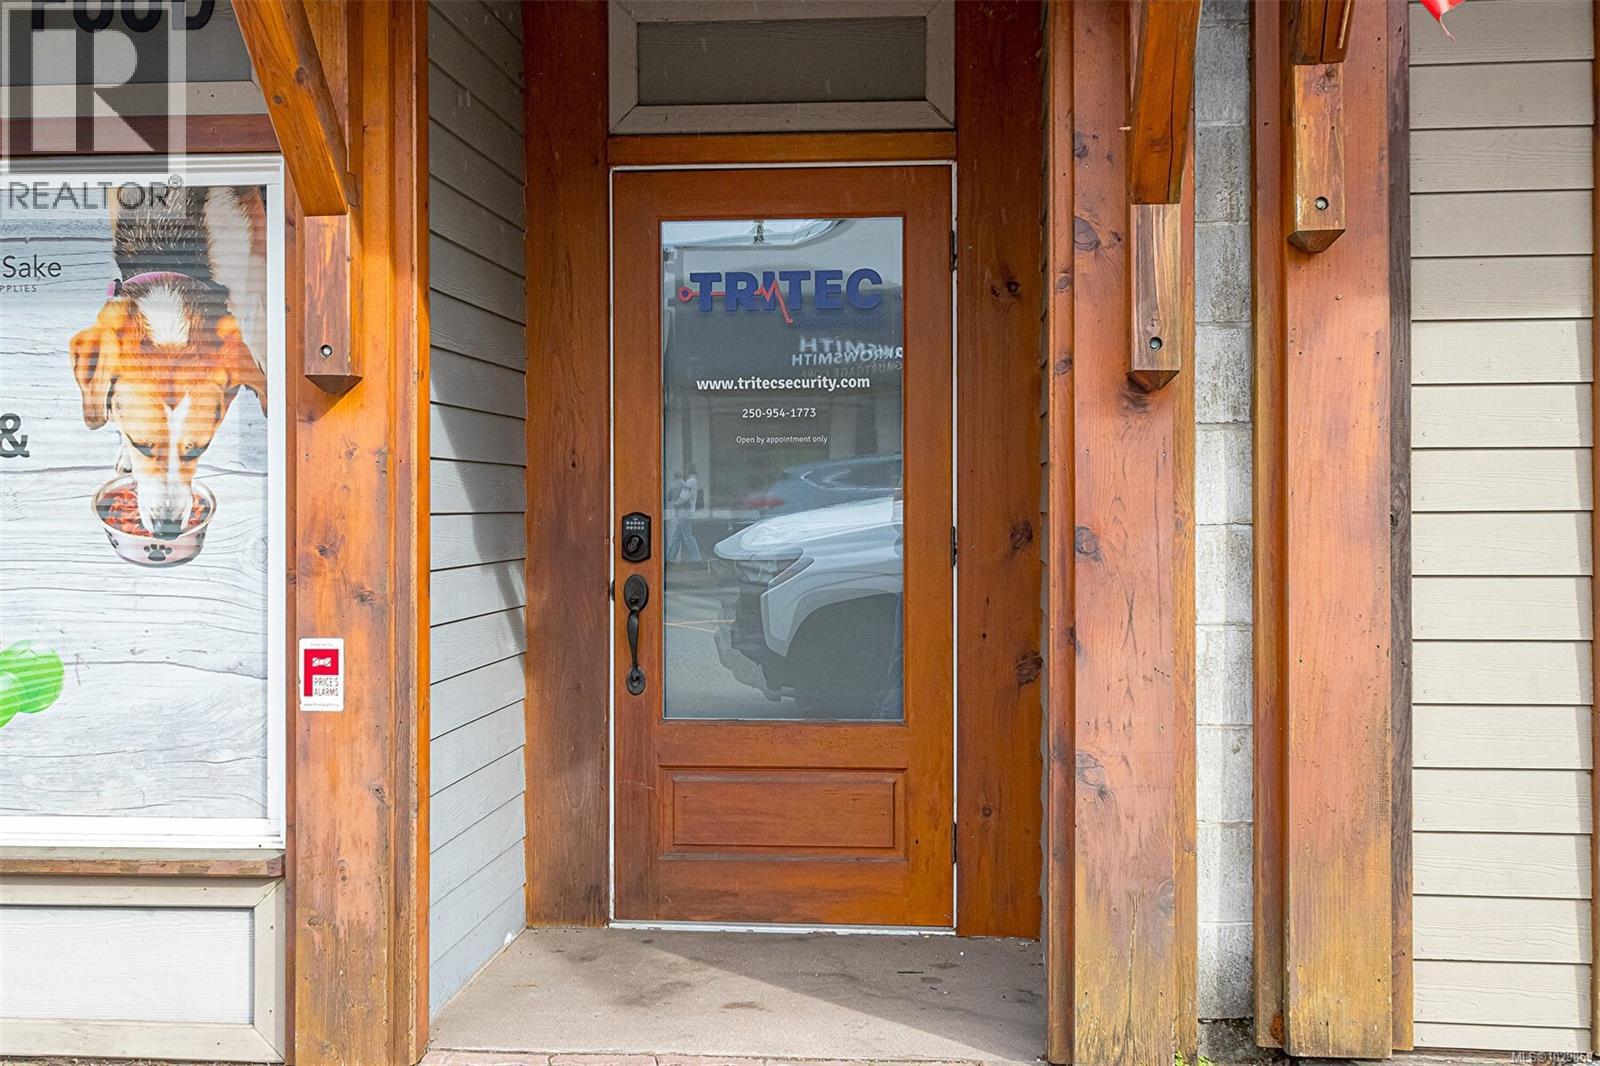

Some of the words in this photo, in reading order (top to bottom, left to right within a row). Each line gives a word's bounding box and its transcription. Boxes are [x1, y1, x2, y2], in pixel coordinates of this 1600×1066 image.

[3, 254, 62, 278] Sake
[689, 268, 883, 313] TRITEC
[696, 375, 870, 392] www.tritecsecurity.com
[742, 407, 816, 419] 250-954-1773
[0, 413, 30, 458] &
[736, 435, 755, 444] Open
[757, 436, 765, 444] by
[766, 435, 811, 444] appointment
[812, 435, 828, 444] only
[314, 688, 339, 697] ALARMS
